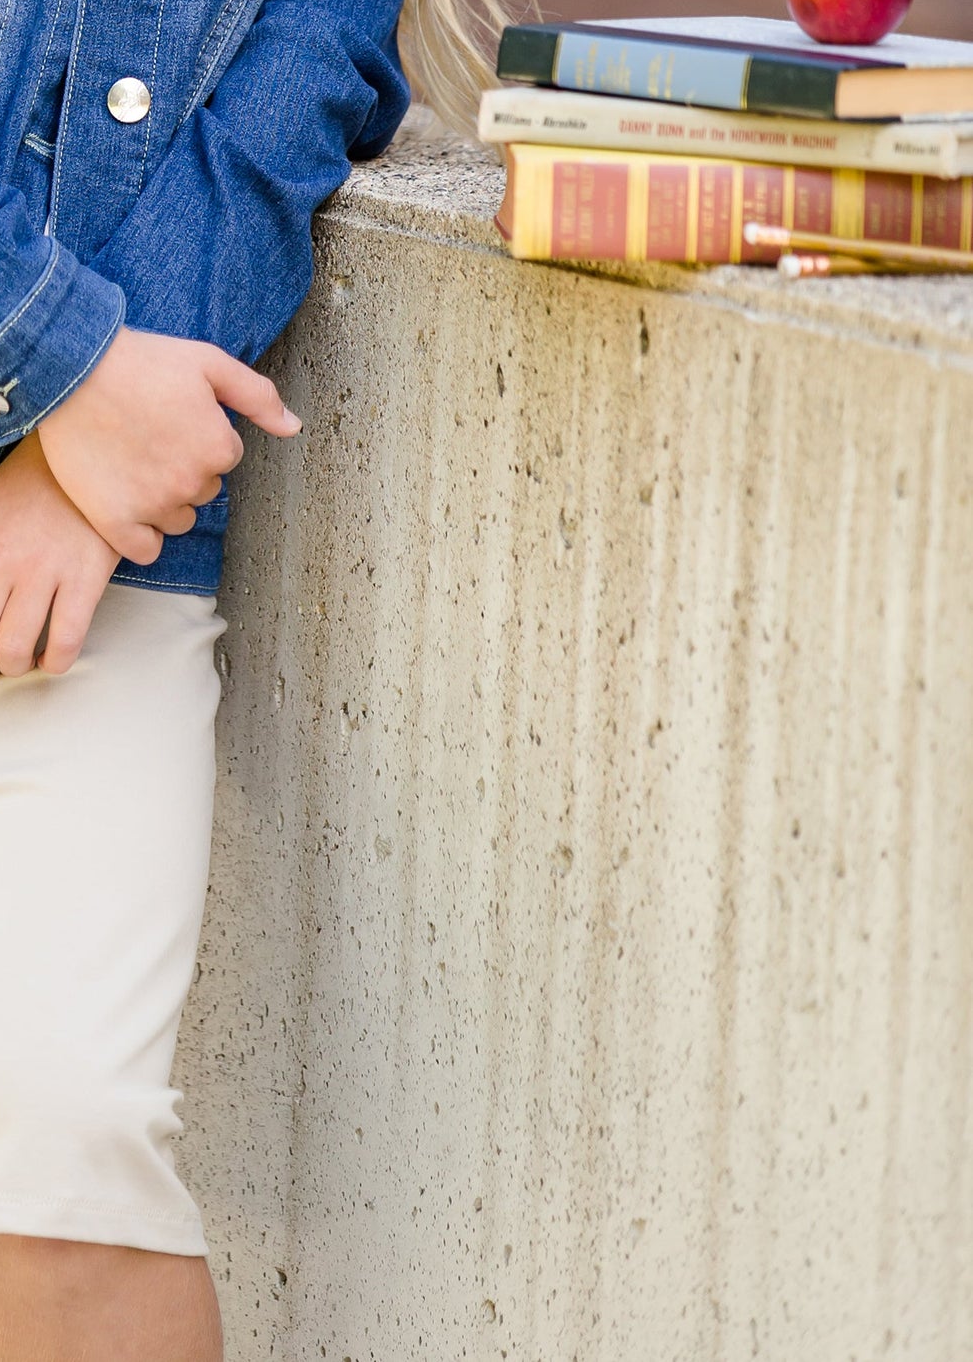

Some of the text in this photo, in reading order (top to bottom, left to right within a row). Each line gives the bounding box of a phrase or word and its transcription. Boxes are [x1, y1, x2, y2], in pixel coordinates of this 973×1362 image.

[493, 113, 532, 126] Williams
[619, 120, 837, 149] DANNY DUNN and the HOMEWORK MACHINE
